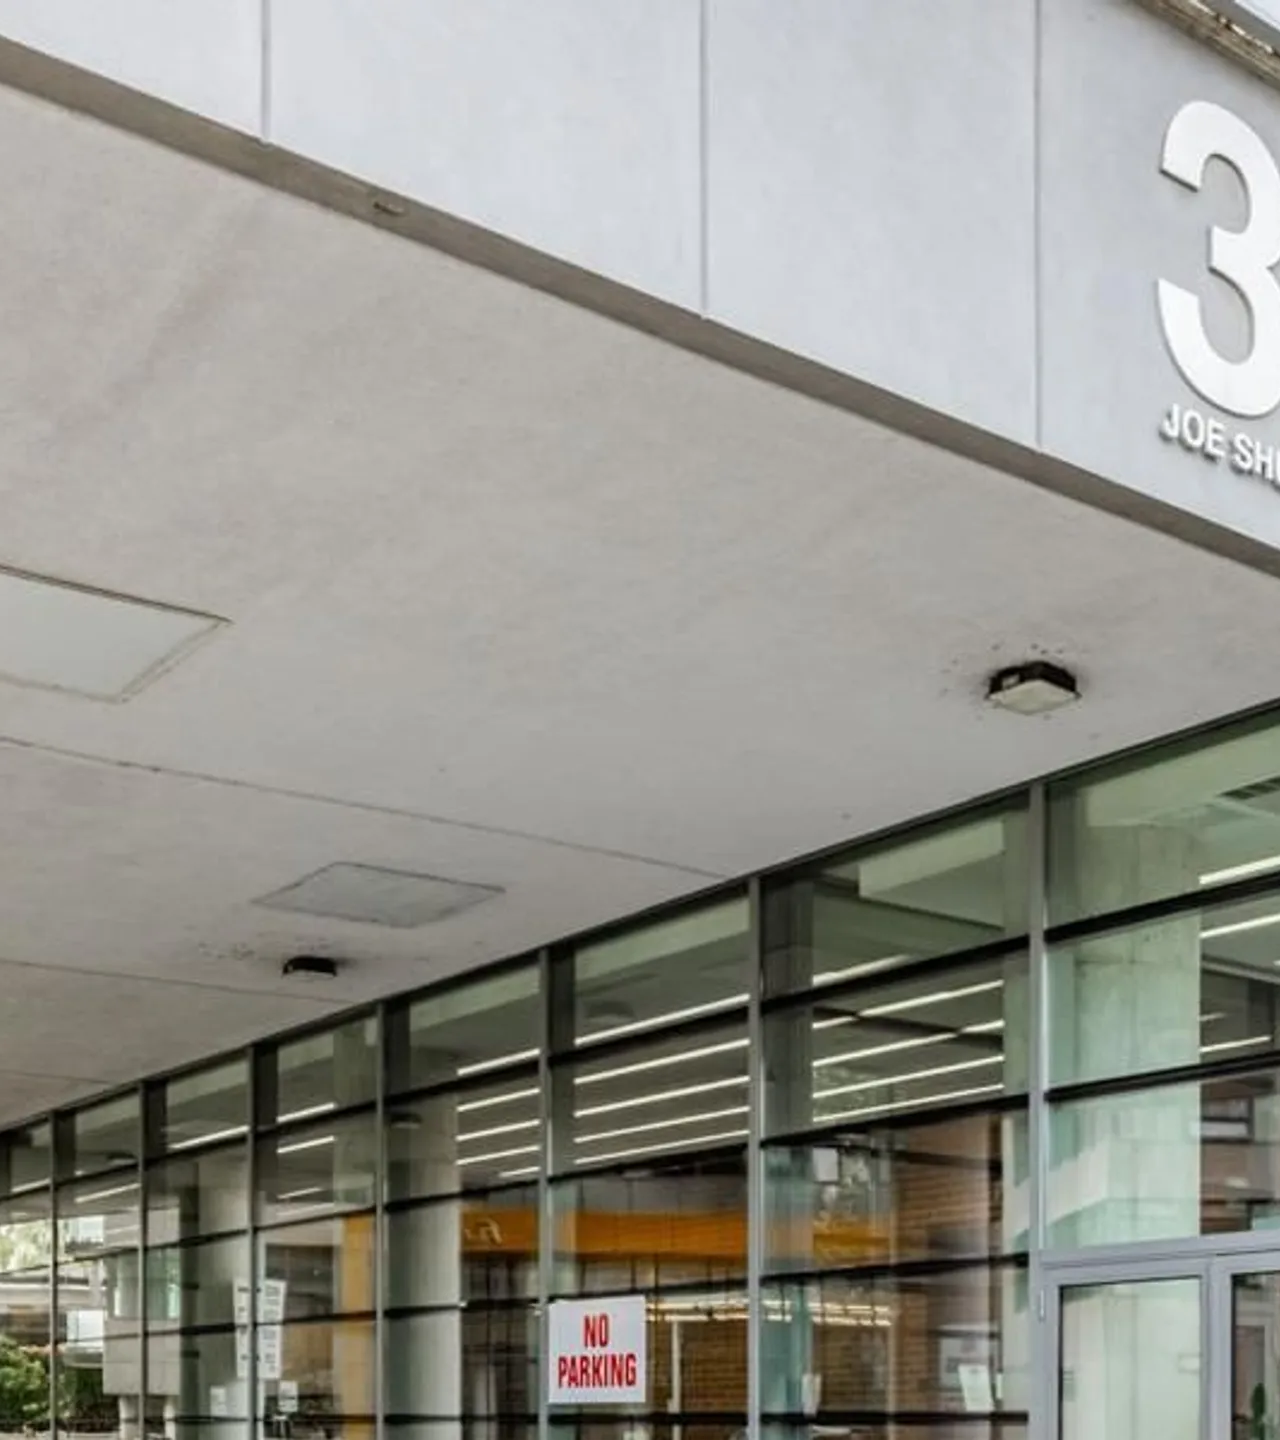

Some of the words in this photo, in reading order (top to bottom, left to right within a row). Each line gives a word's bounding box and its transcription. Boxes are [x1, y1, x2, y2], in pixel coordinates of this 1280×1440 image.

[1161, 404, 1225, 459] JOE
[584, 1313, 610, 1348] NO
[557, 1353, 637, 1388] PARKING
